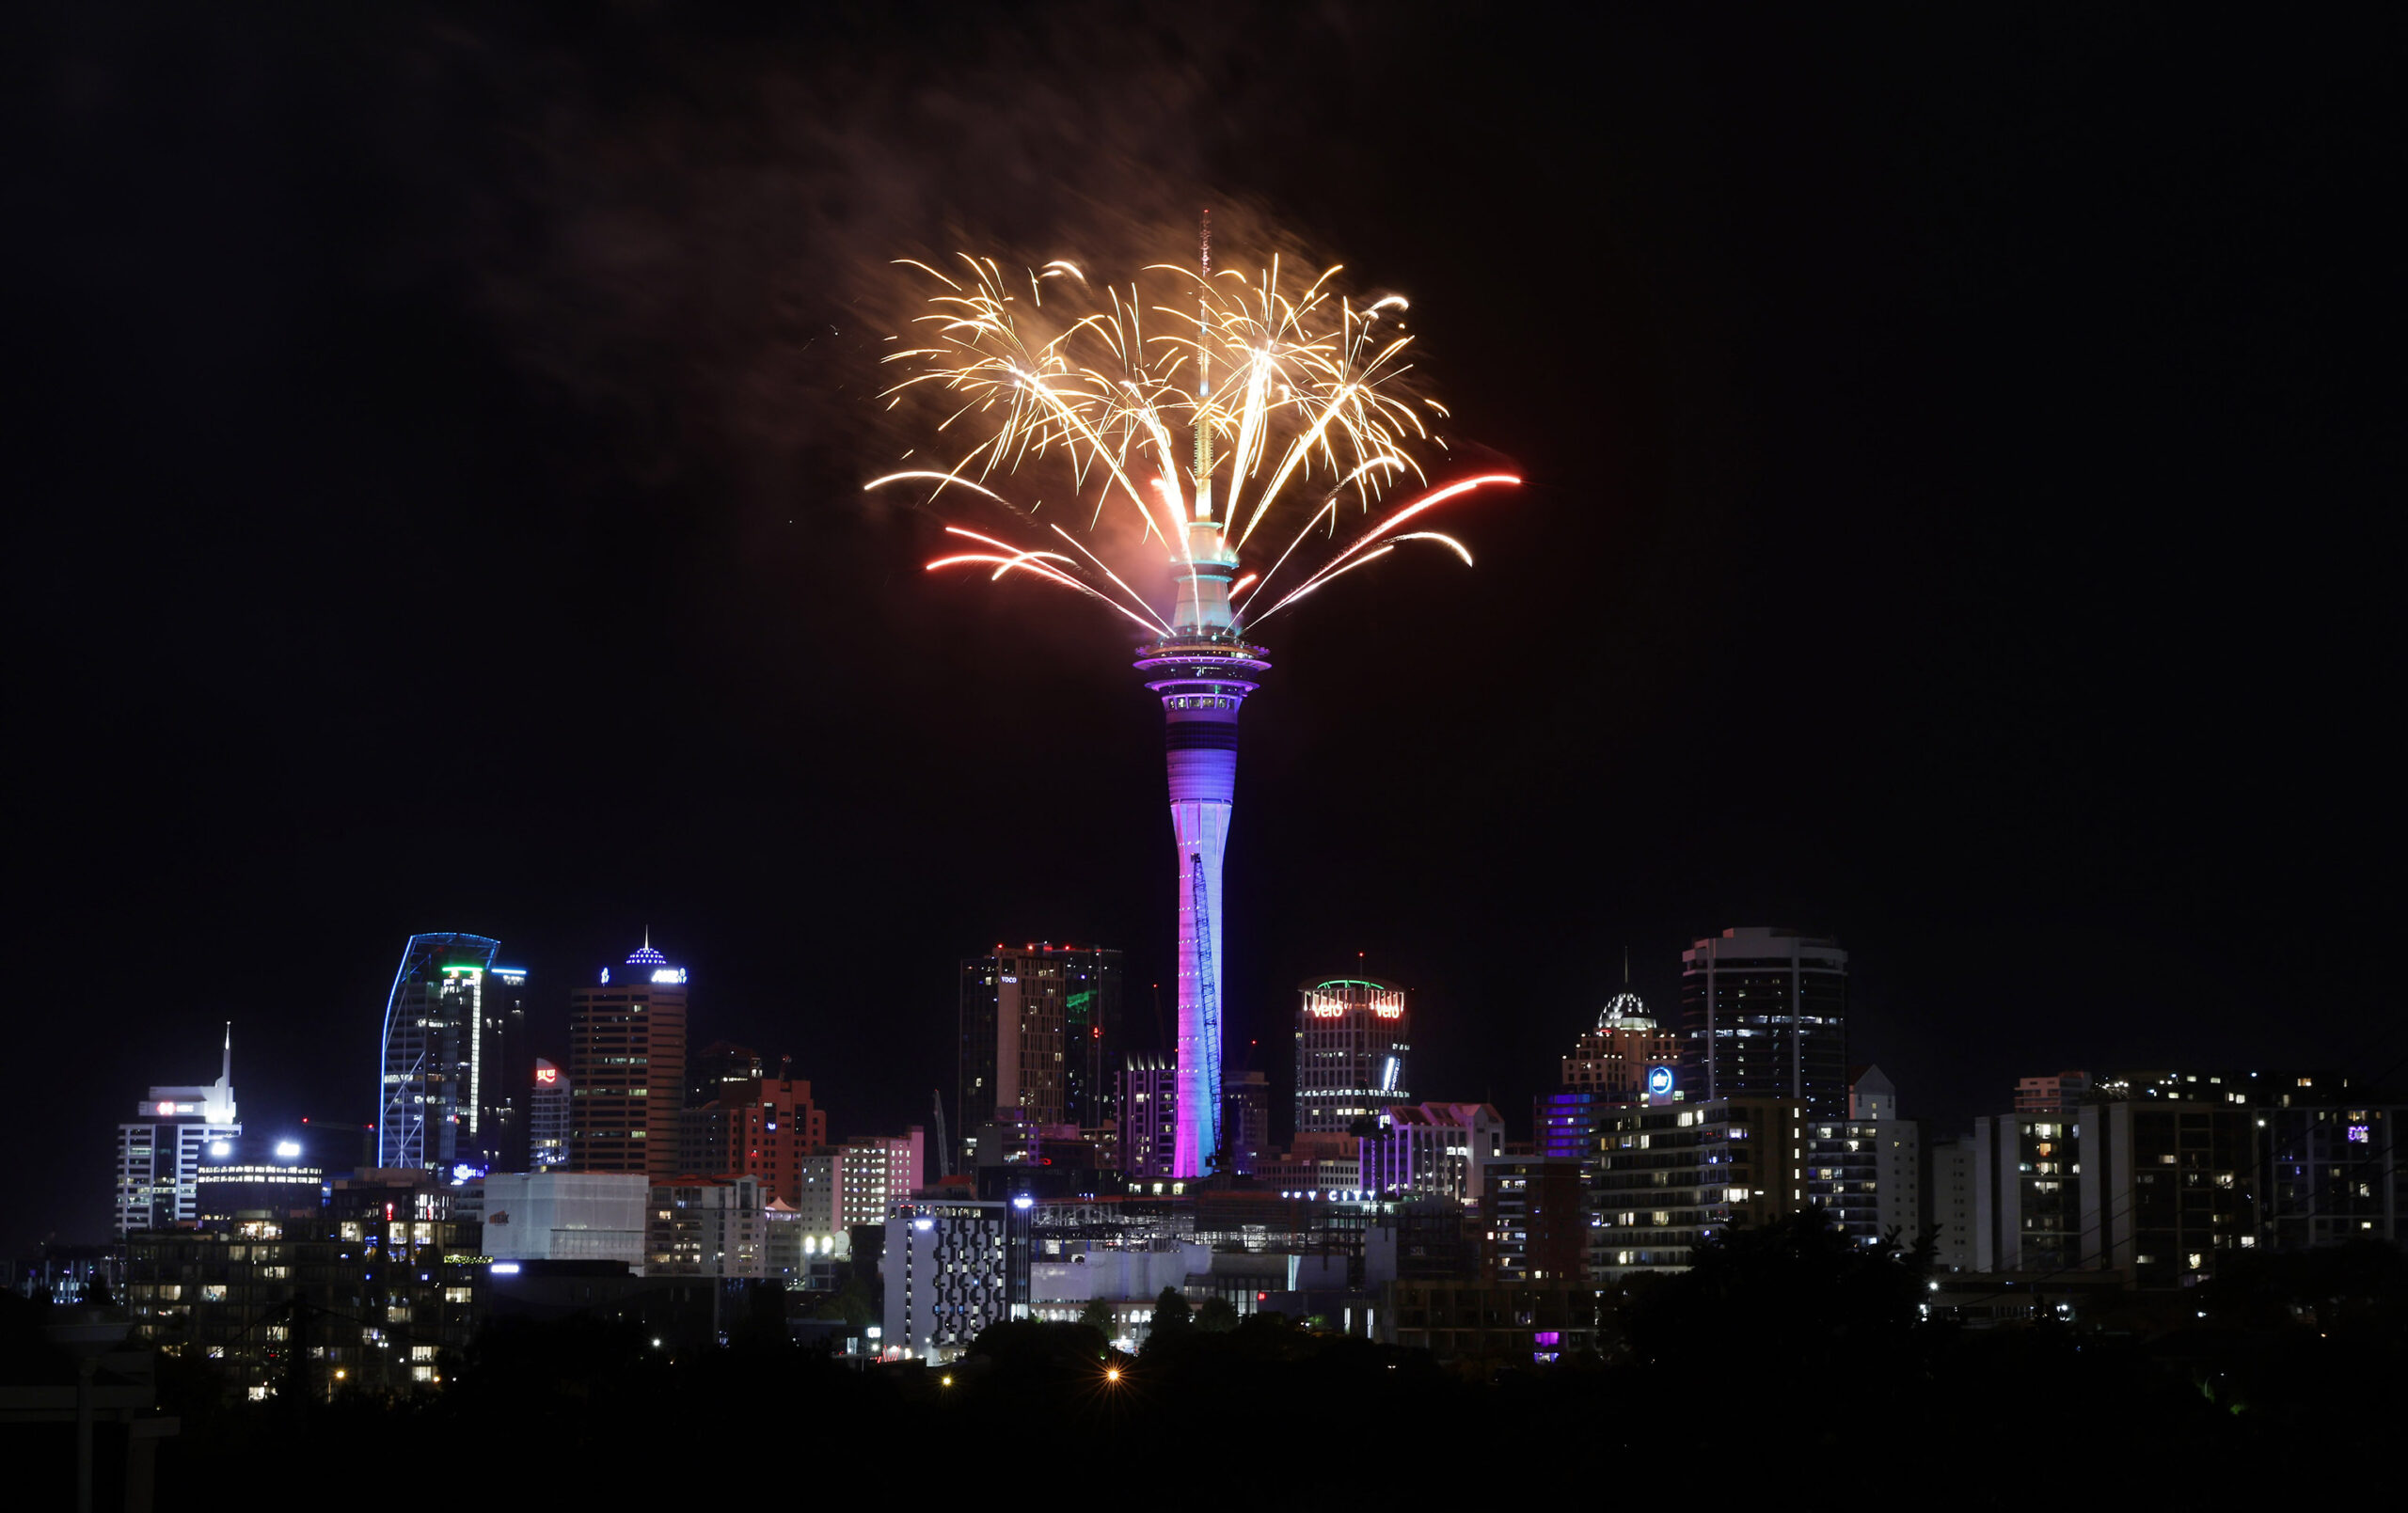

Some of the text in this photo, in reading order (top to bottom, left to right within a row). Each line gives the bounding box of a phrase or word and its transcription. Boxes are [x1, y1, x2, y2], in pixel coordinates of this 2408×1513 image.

[1313, 1004, 1343, 1017] vero
[1376, 1004, 1400, 1018] vero
[1328, 1190, 1375, 1202] CITY
